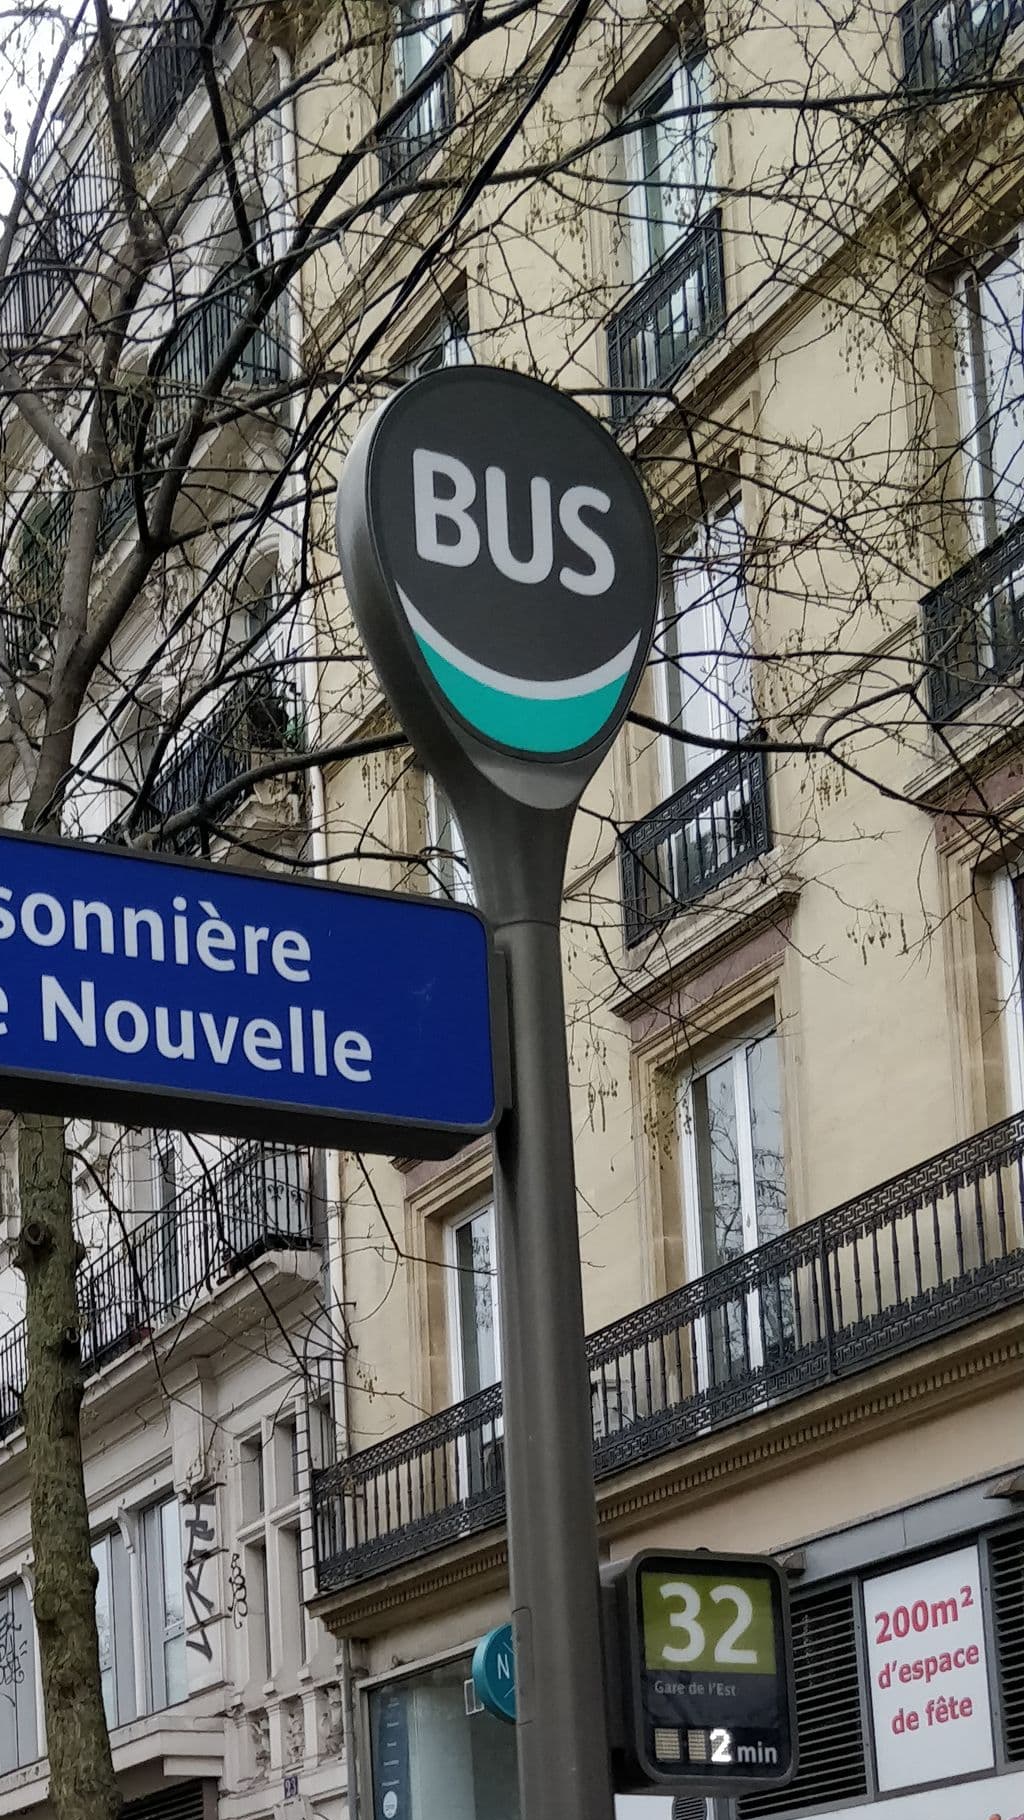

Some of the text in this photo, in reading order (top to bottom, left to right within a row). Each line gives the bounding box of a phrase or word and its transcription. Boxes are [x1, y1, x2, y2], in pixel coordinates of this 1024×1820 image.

[413, 448, 615, 596] BUS
[42, 974, 372, 1082] Nouvelle
[660, 1582, 757, 1664] 32
[655, 1681, 736, 1696] Gare de l'Est
[878, 1644, 979, 1689] d'espace
[892, 1696, 973, 1734] de fête
[710, 1728, 777, 1763] 2 min
